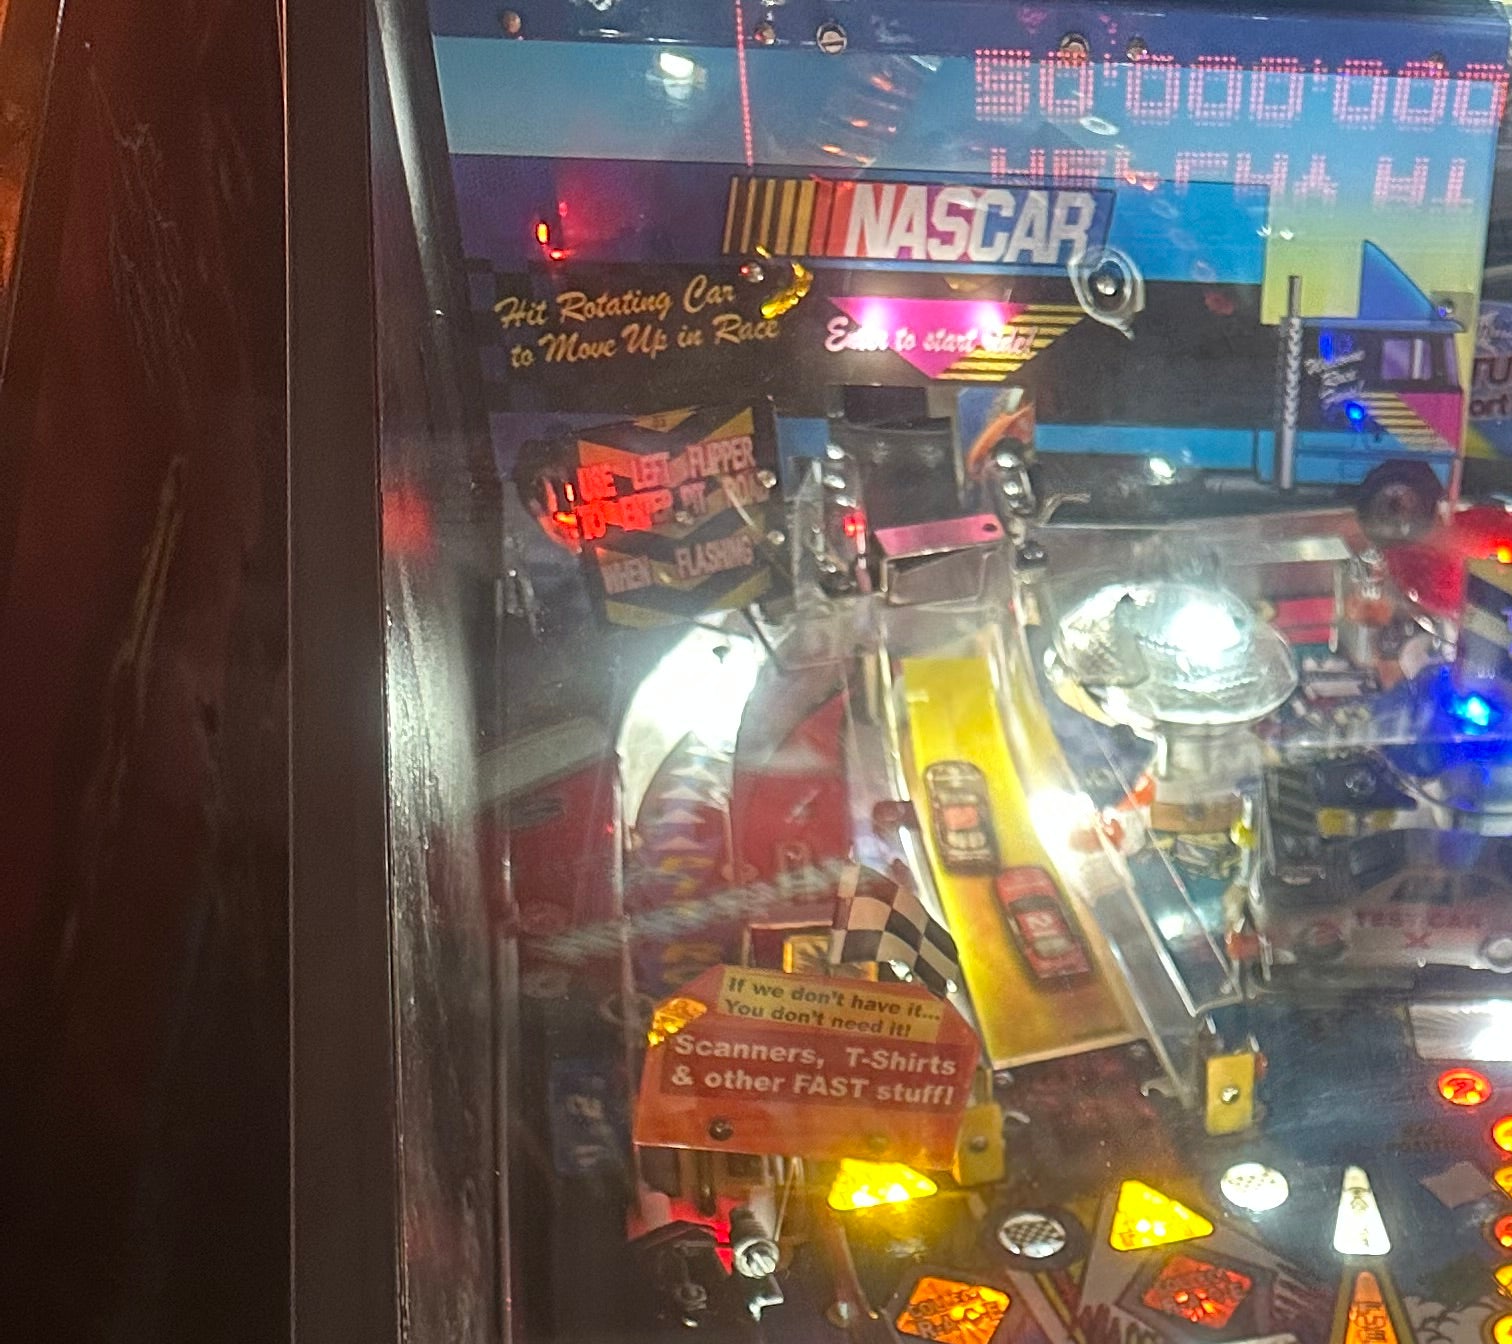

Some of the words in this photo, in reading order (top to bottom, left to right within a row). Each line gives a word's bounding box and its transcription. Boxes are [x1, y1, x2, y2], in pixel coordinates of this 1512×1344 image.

[844, 182, 1096, 264] NASCAR
[495, 296, 547, 328] Hit
[556, 290, 672, 323] Rotating
[684, 274, 735, 313] Car
[510, 343, 535, 368] to
[538, 331, 618, 363] Move
[622, 323, 668, 359] Up
[677, 325, 702, 348] in
[712, 313, 780, 344] Race
[896, 328, 917, 352] to
[923, 328, 979, 353] start
[724, 999, 765, 1020] You
[770, 1009, 825, 1027] don't
[831, 1018, 883, 1034] need
[728, 977, 743, 993] If
[751, 981, 785, 999] we
[790, 987, 845, 1007] don't
[850, 996, 901, 1015] have
[674, 1033, 826, 1069] Scanners,
[846, 1046, 957, 1075] T-Shirts
[671, 1064, 694, 1087] &
[703, 1068, 786, 1092] other
[793, 1073, 870, 1098] FAST
[876, 1083, 955, 1105] stuff!
